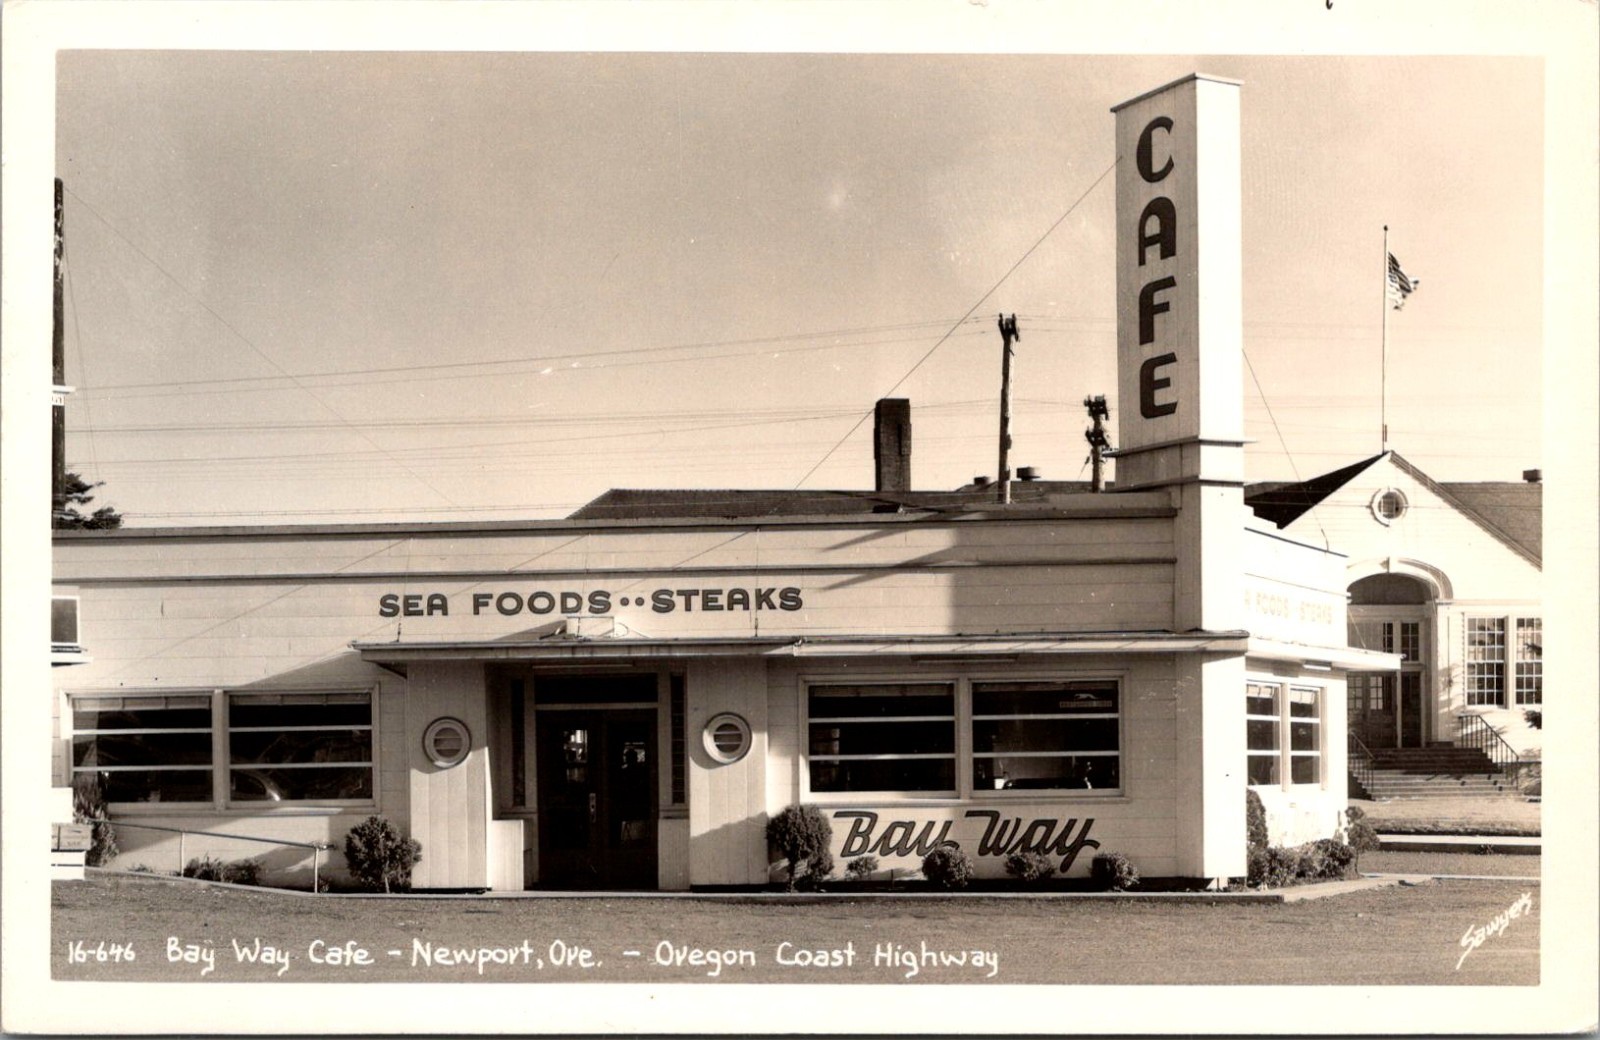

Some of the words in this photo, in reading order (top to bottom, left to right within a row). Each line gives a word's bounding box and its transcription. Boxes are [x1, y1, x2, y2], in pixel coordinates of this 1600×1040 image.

[1136, 116, 1178, 420] CAFE
[379, 593, 449, 618] SEA
[472, 590, 612, 617] FOODS
[651, 586, 803, 614] STEAKS
[833, 810, 960, 858] Bay
[964, 809, 1101, 874] Way
